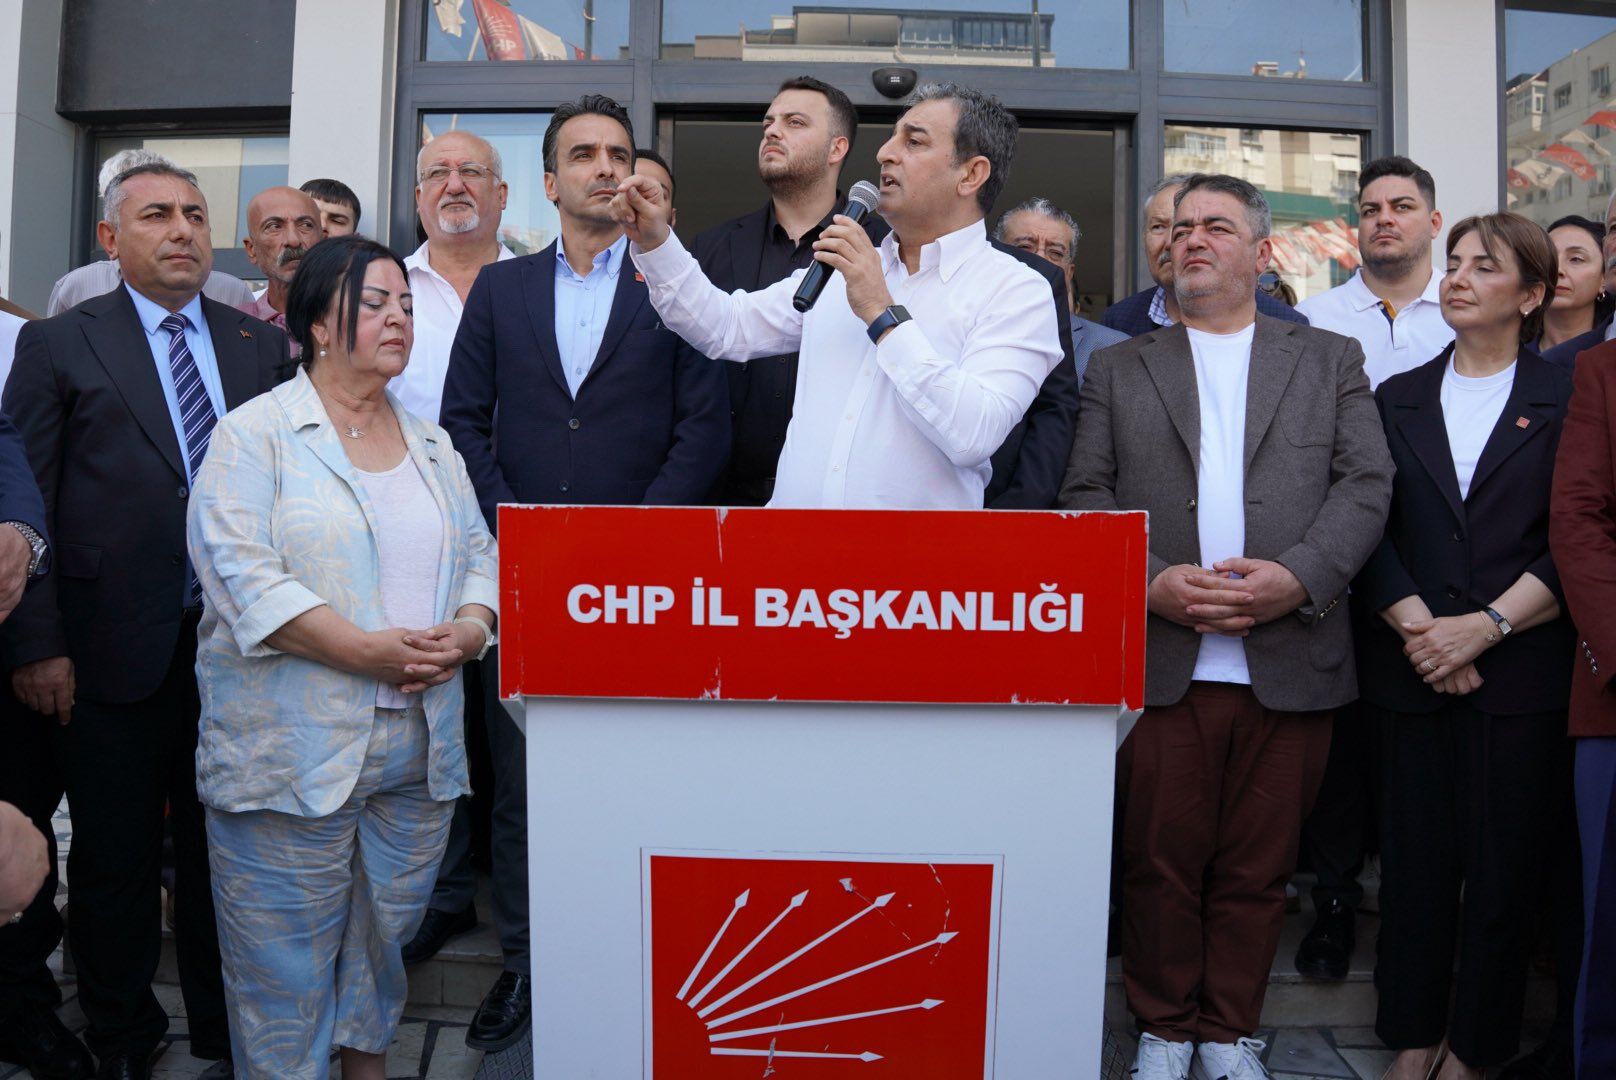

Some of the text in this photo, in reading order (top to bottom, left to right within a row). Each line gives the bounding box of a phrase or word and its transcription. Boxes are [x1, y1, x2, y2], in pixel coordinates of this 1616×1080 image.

[490, 38, 517, 53] HP
[567, 577, 1084, 640] CHP İL BAŞKANLIĞI
